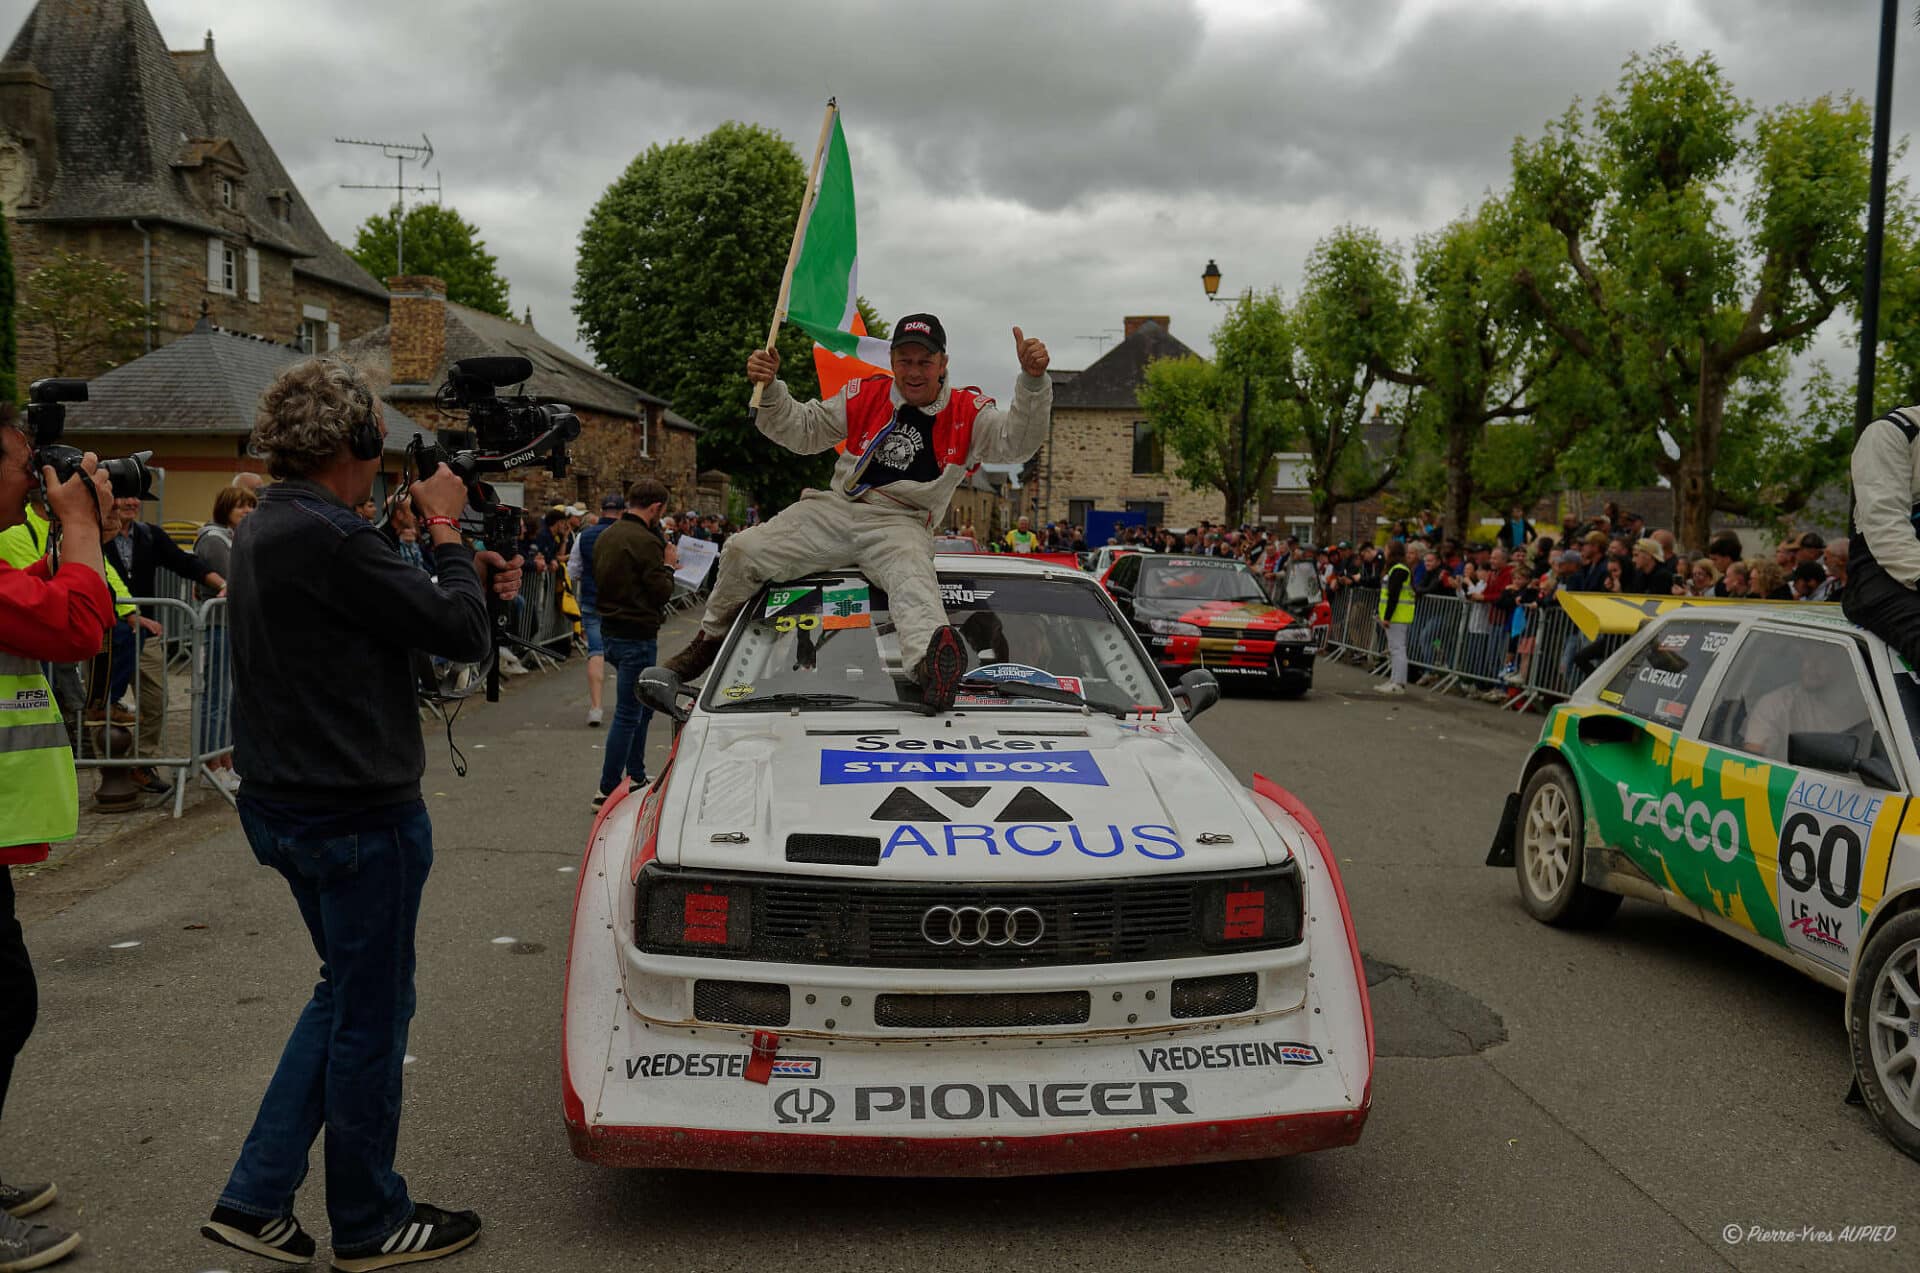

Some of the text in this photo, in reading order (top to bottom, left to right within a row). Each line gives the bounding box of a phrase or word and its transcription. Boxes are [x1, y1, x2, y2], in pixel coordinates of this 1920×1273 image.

[503, 450, 536, 469] RONIN
[772, 592, 791, 604] 59
[855, 735, 1059, 752] Senker
[843, 760, 1079, 773] STANDOX
[1790, 780, 1883, 825] ACUVUE
[1616, 780, 1740, 864] YACCO
[880, 824, 1186, 860] ARCUS
[1778, 812, 1862, 909] 60
[625, 1053, 749, 1080] VREDESTEI
[1138, 1041, 1283, 1073] VREDESTEIN
[855, 1081, 1195, 1121] PIONEER
